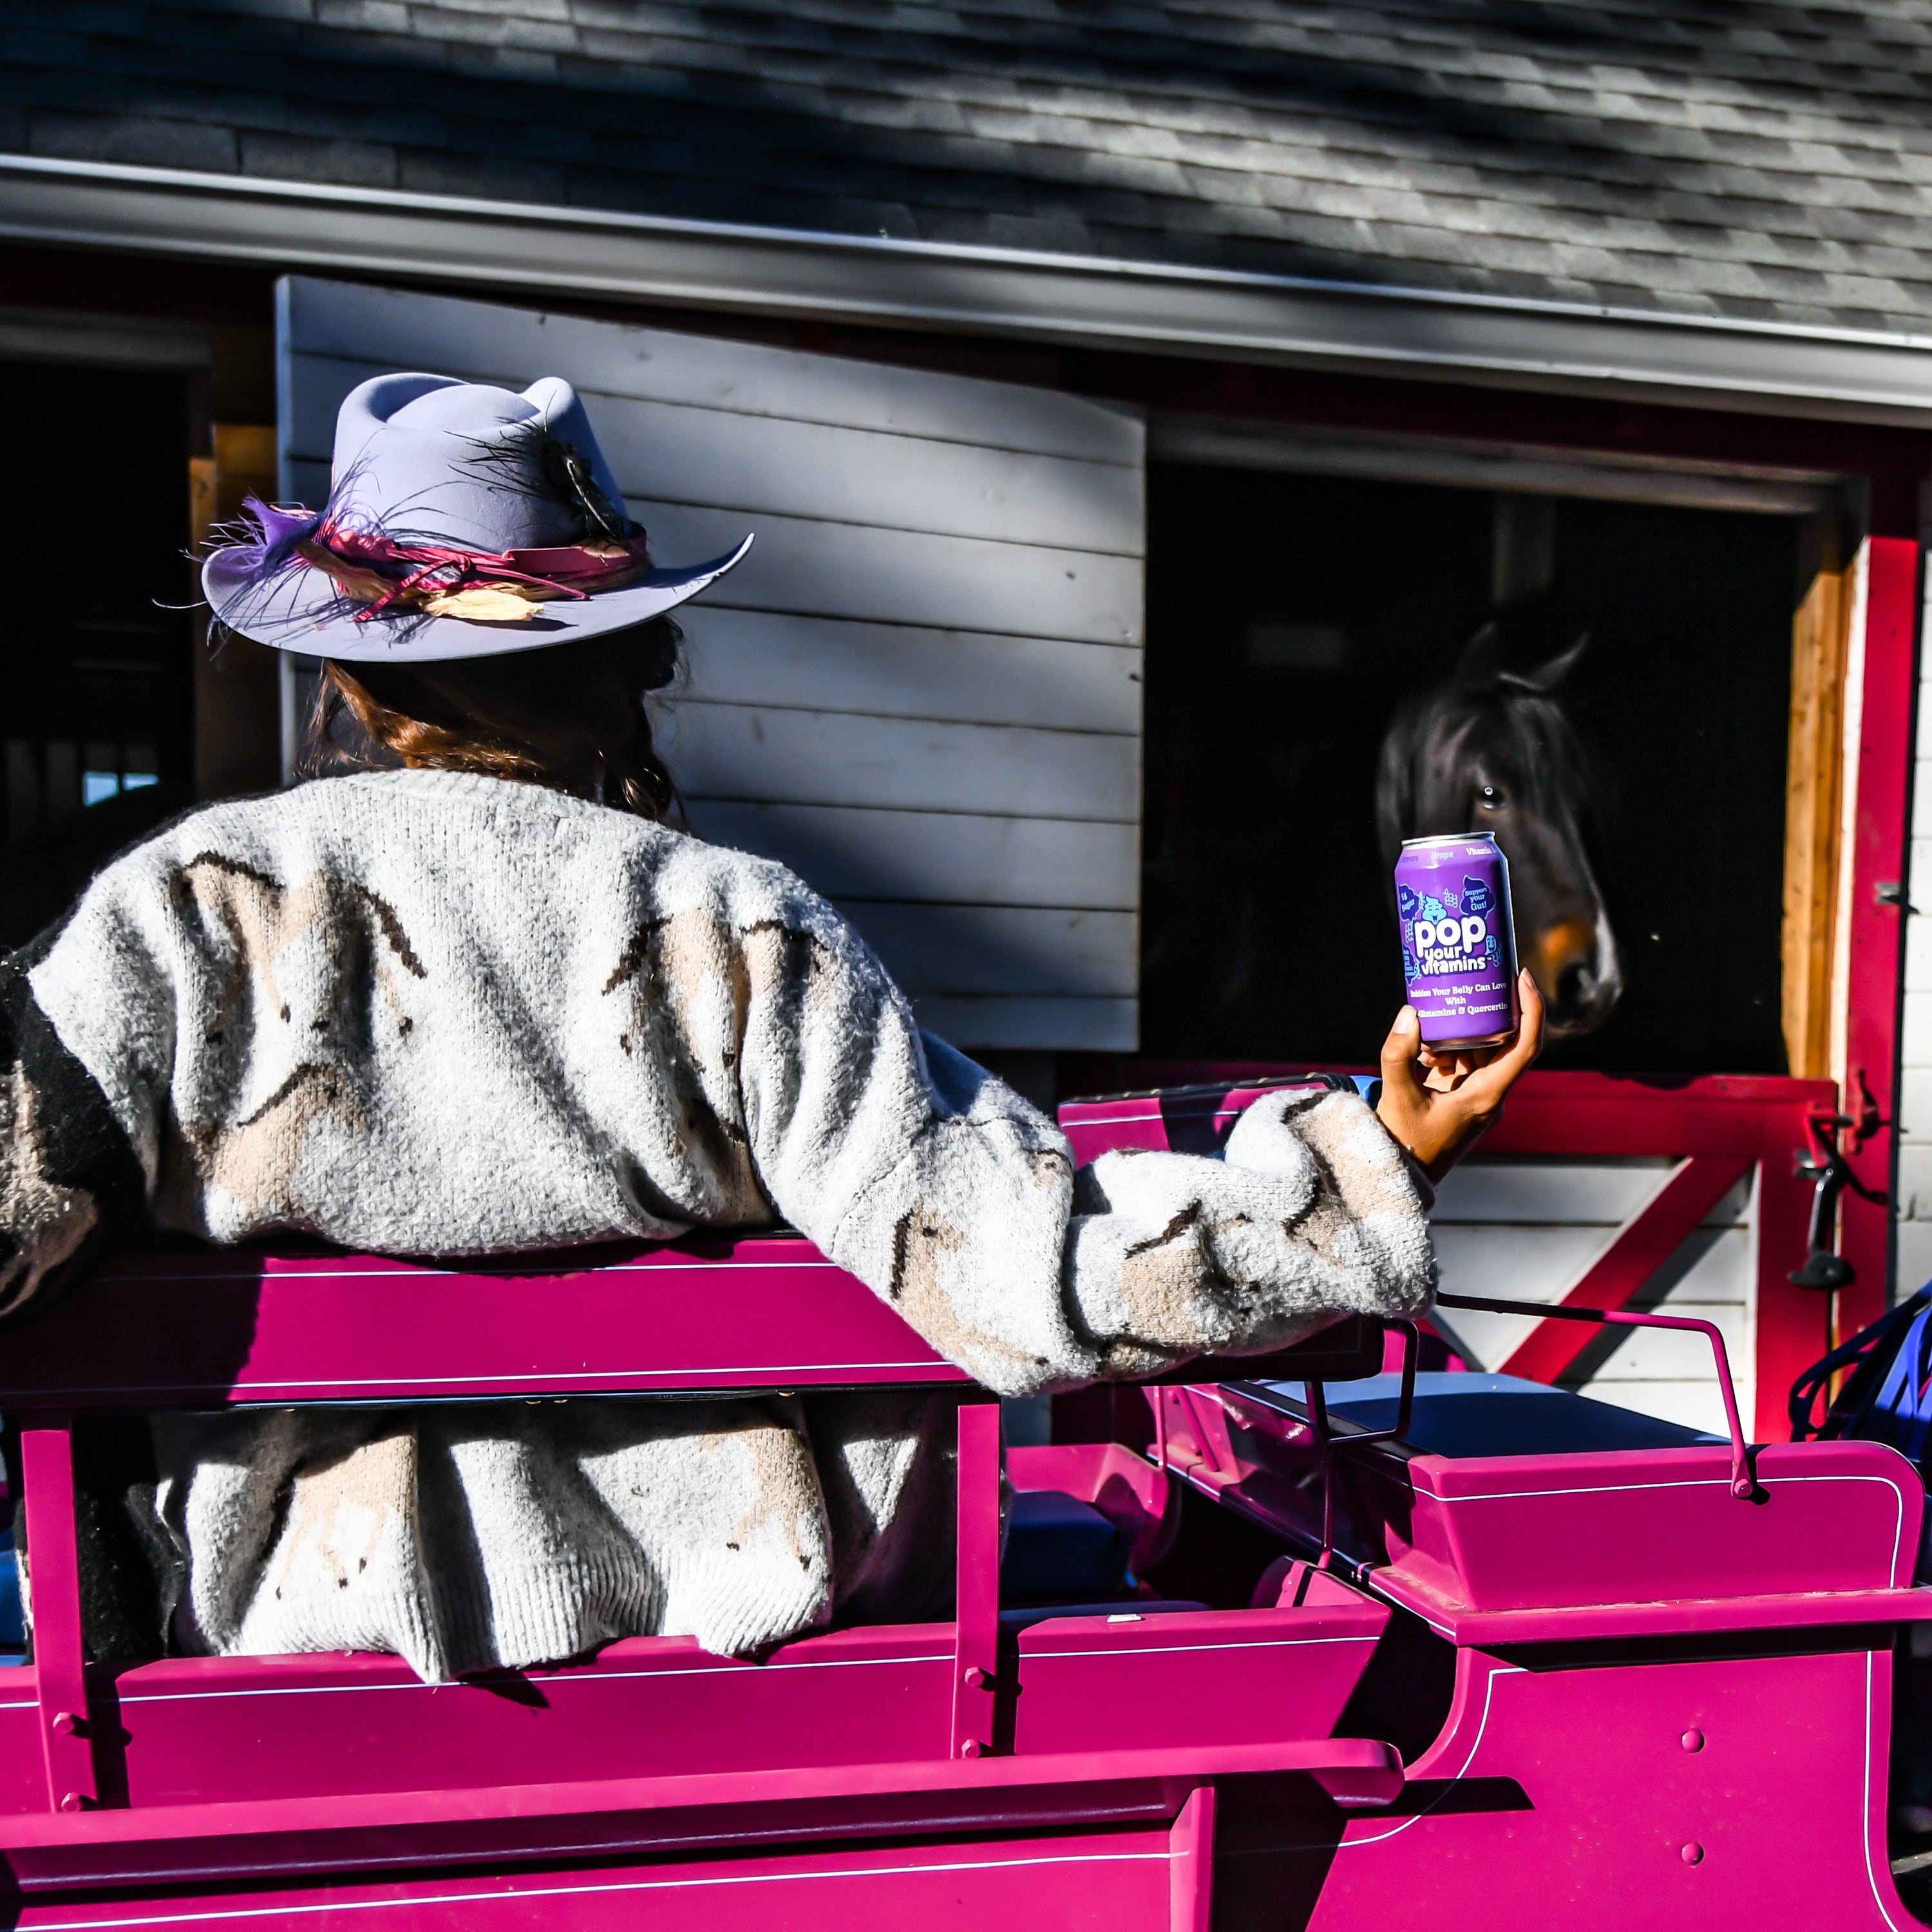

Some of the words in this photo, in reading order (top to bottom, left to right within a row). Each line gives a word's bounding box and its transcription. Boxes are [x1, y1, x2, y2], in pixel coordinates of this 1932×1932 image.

[1431, 851, 1454, 860] Grape
[1464, 887, 1487, 896] Support
[1470, 894, 1485, 903] your
[1470, 900, 1487, 911] Gut!
[1414, 916, 1486, 958] pop
[1425, 946, 1463, 960] your
[1432, 987, 1451, 996] Your
[1452, 985, 1473, 995] Belly
[1475, 983, 1491, 992] Can
[1445, 996, 1466, 1005] With
[1458, 1007, 1465, 1015] &
